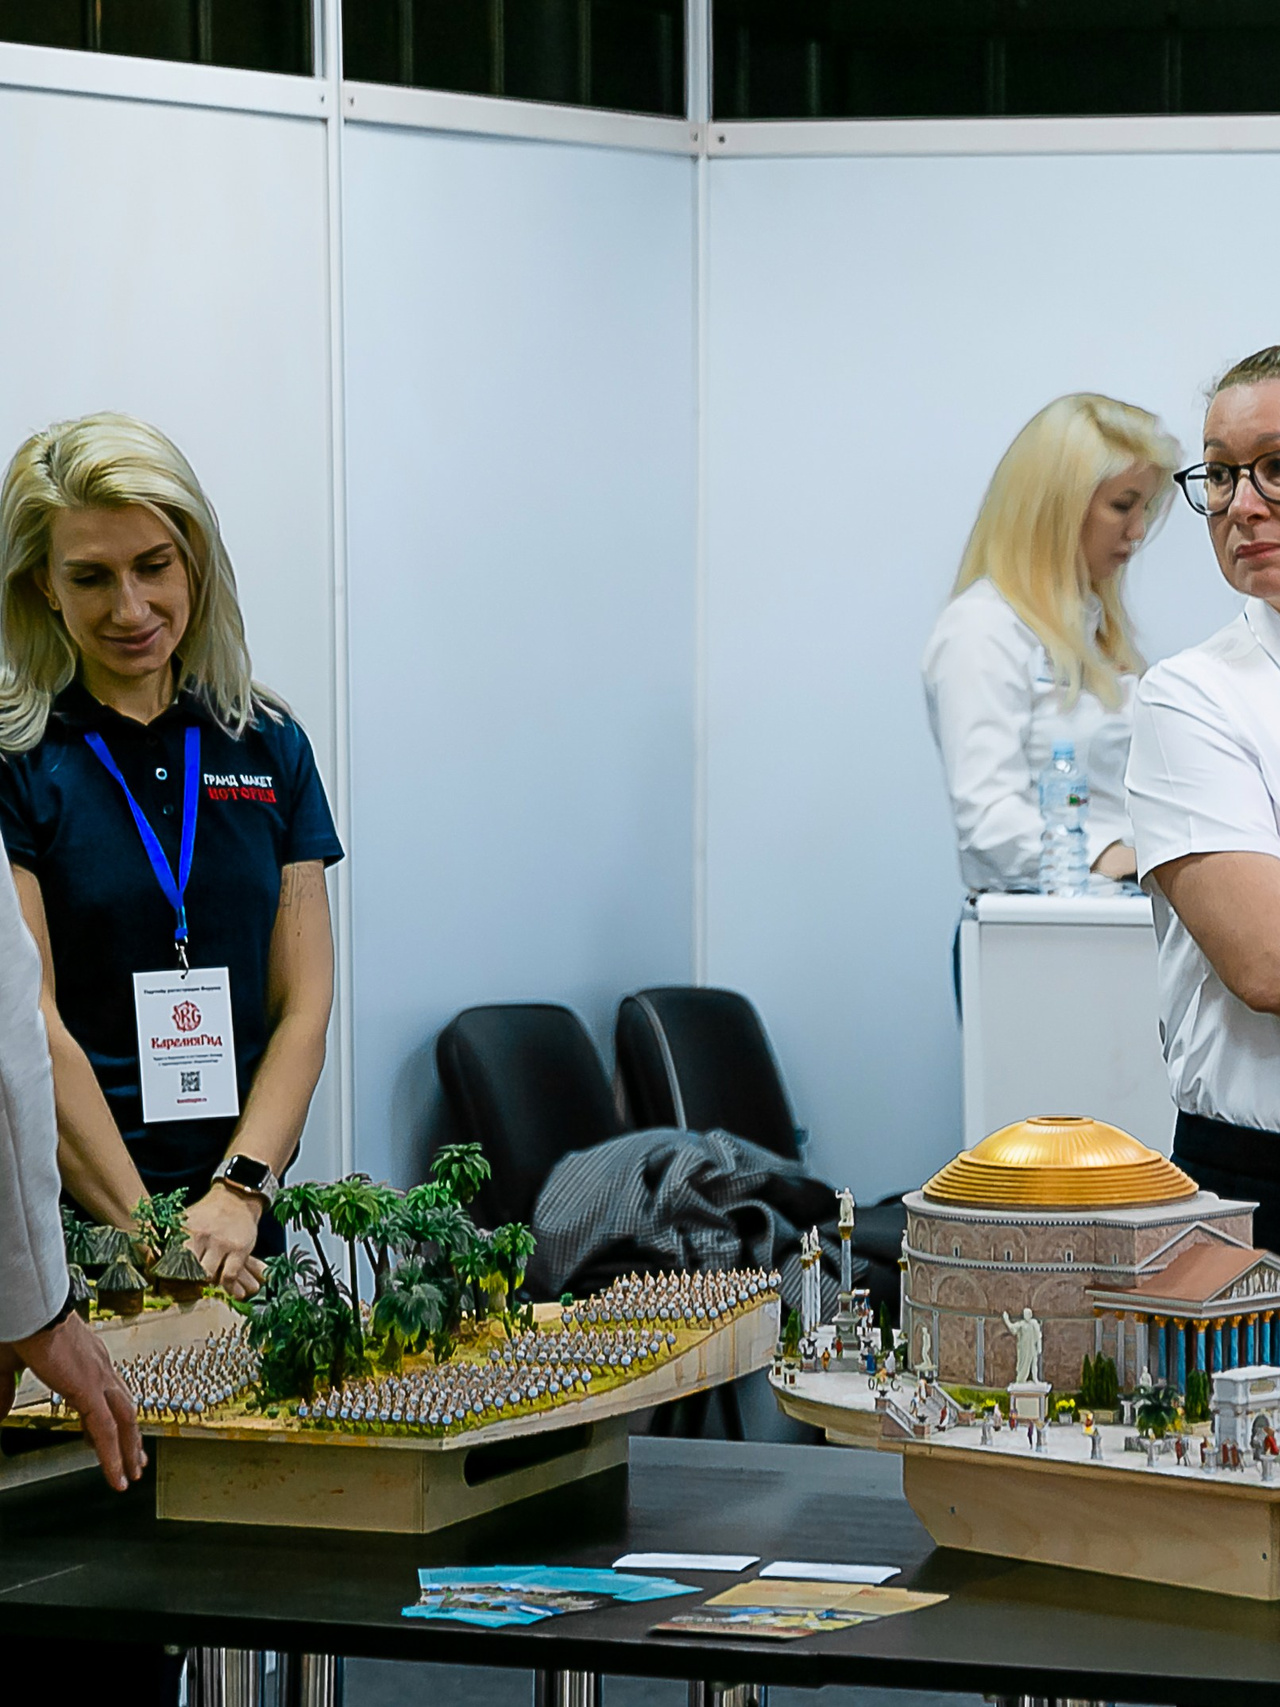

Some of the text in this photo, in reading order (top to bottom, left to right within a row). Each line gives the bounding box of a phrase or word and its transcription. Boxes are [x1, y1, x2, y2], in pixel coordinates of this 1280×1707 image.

[203, 773, 272, 788] ГРАНД МАКЕТ
[151, 1034, 223, 1050] КарелияГид
